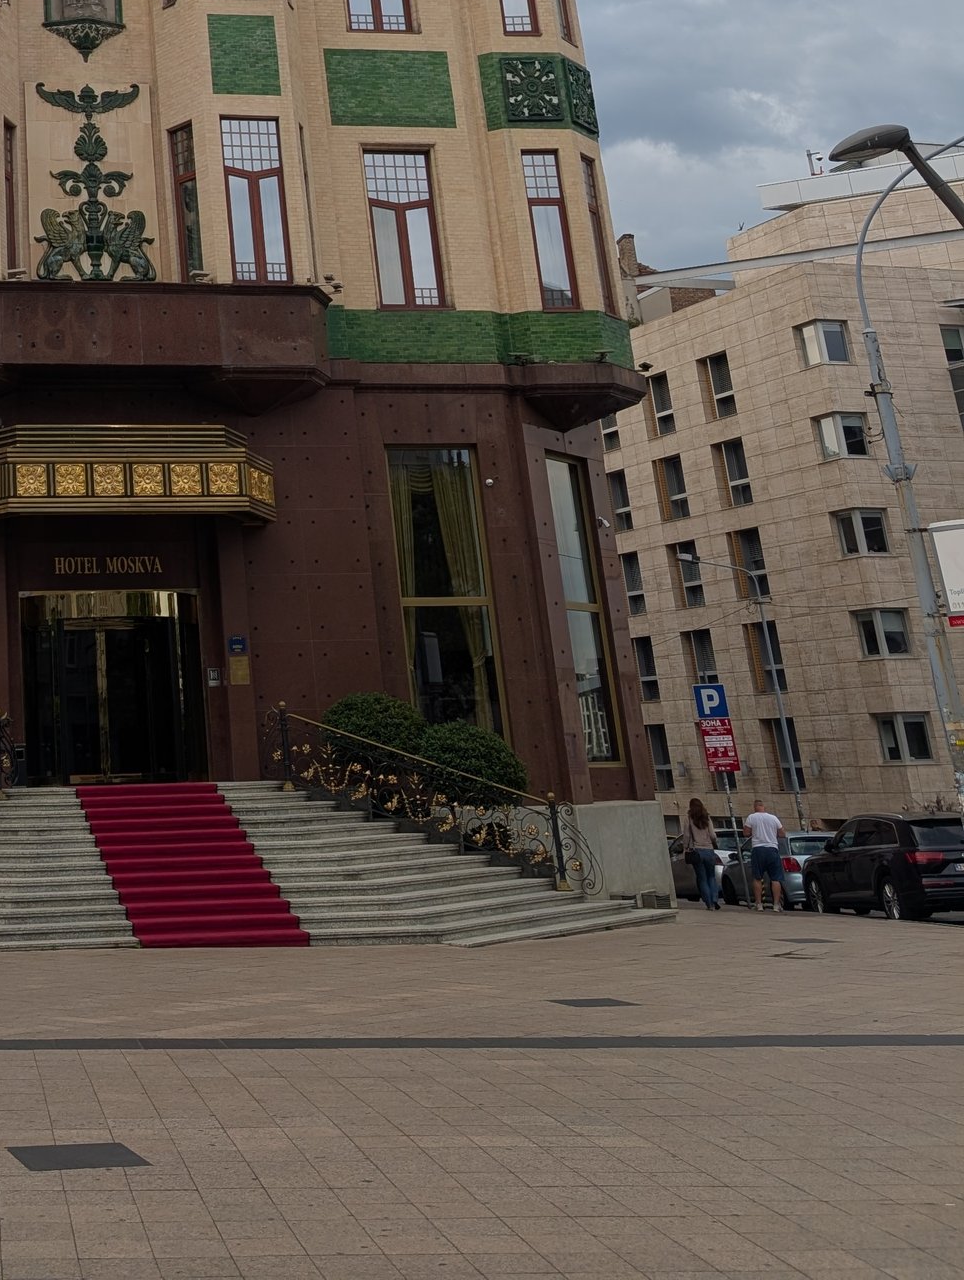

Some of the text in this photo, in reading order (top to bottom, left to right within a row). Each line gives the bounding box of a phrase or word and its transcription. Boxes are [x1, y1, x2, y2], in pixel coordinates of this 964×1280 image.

[54, 556, 163, 575] HOTEL MOSKVA
[700, 688, 720, 715] P
